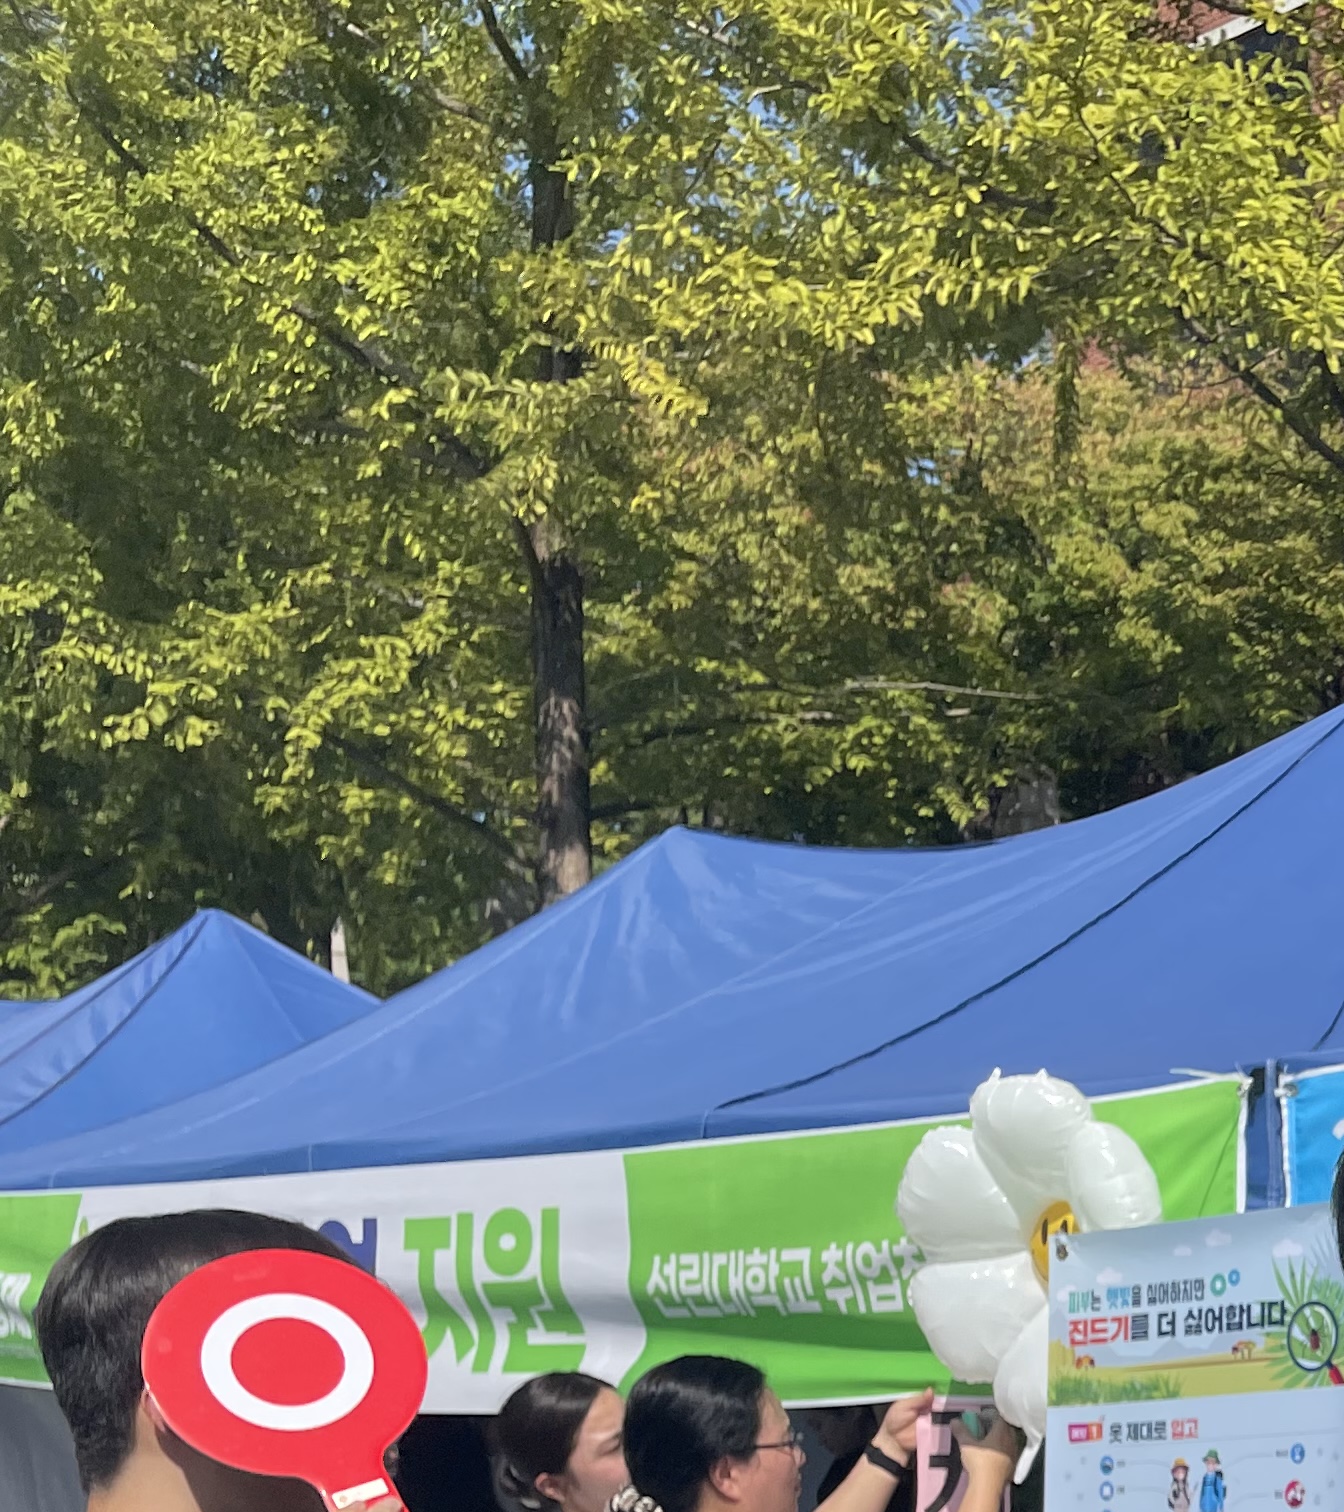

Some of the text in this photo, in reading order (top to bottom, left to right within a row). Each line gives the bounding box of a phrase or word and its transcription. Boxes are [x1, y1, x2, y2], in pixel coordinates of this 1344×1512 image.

[403, 1206, 588, 1374] 지원
[646, 1246, 823, 1319] 선린대학교
[1068, 1278, 1205, 1314] 피부는 햇빛을 싫어하지만
[1068, 1299, 1288, 1346] 진드기를 더 싫어합니다
[1126, 1419, 1168, 1442] 제대로
[1171, 1417, 1199, 1440] 입고
